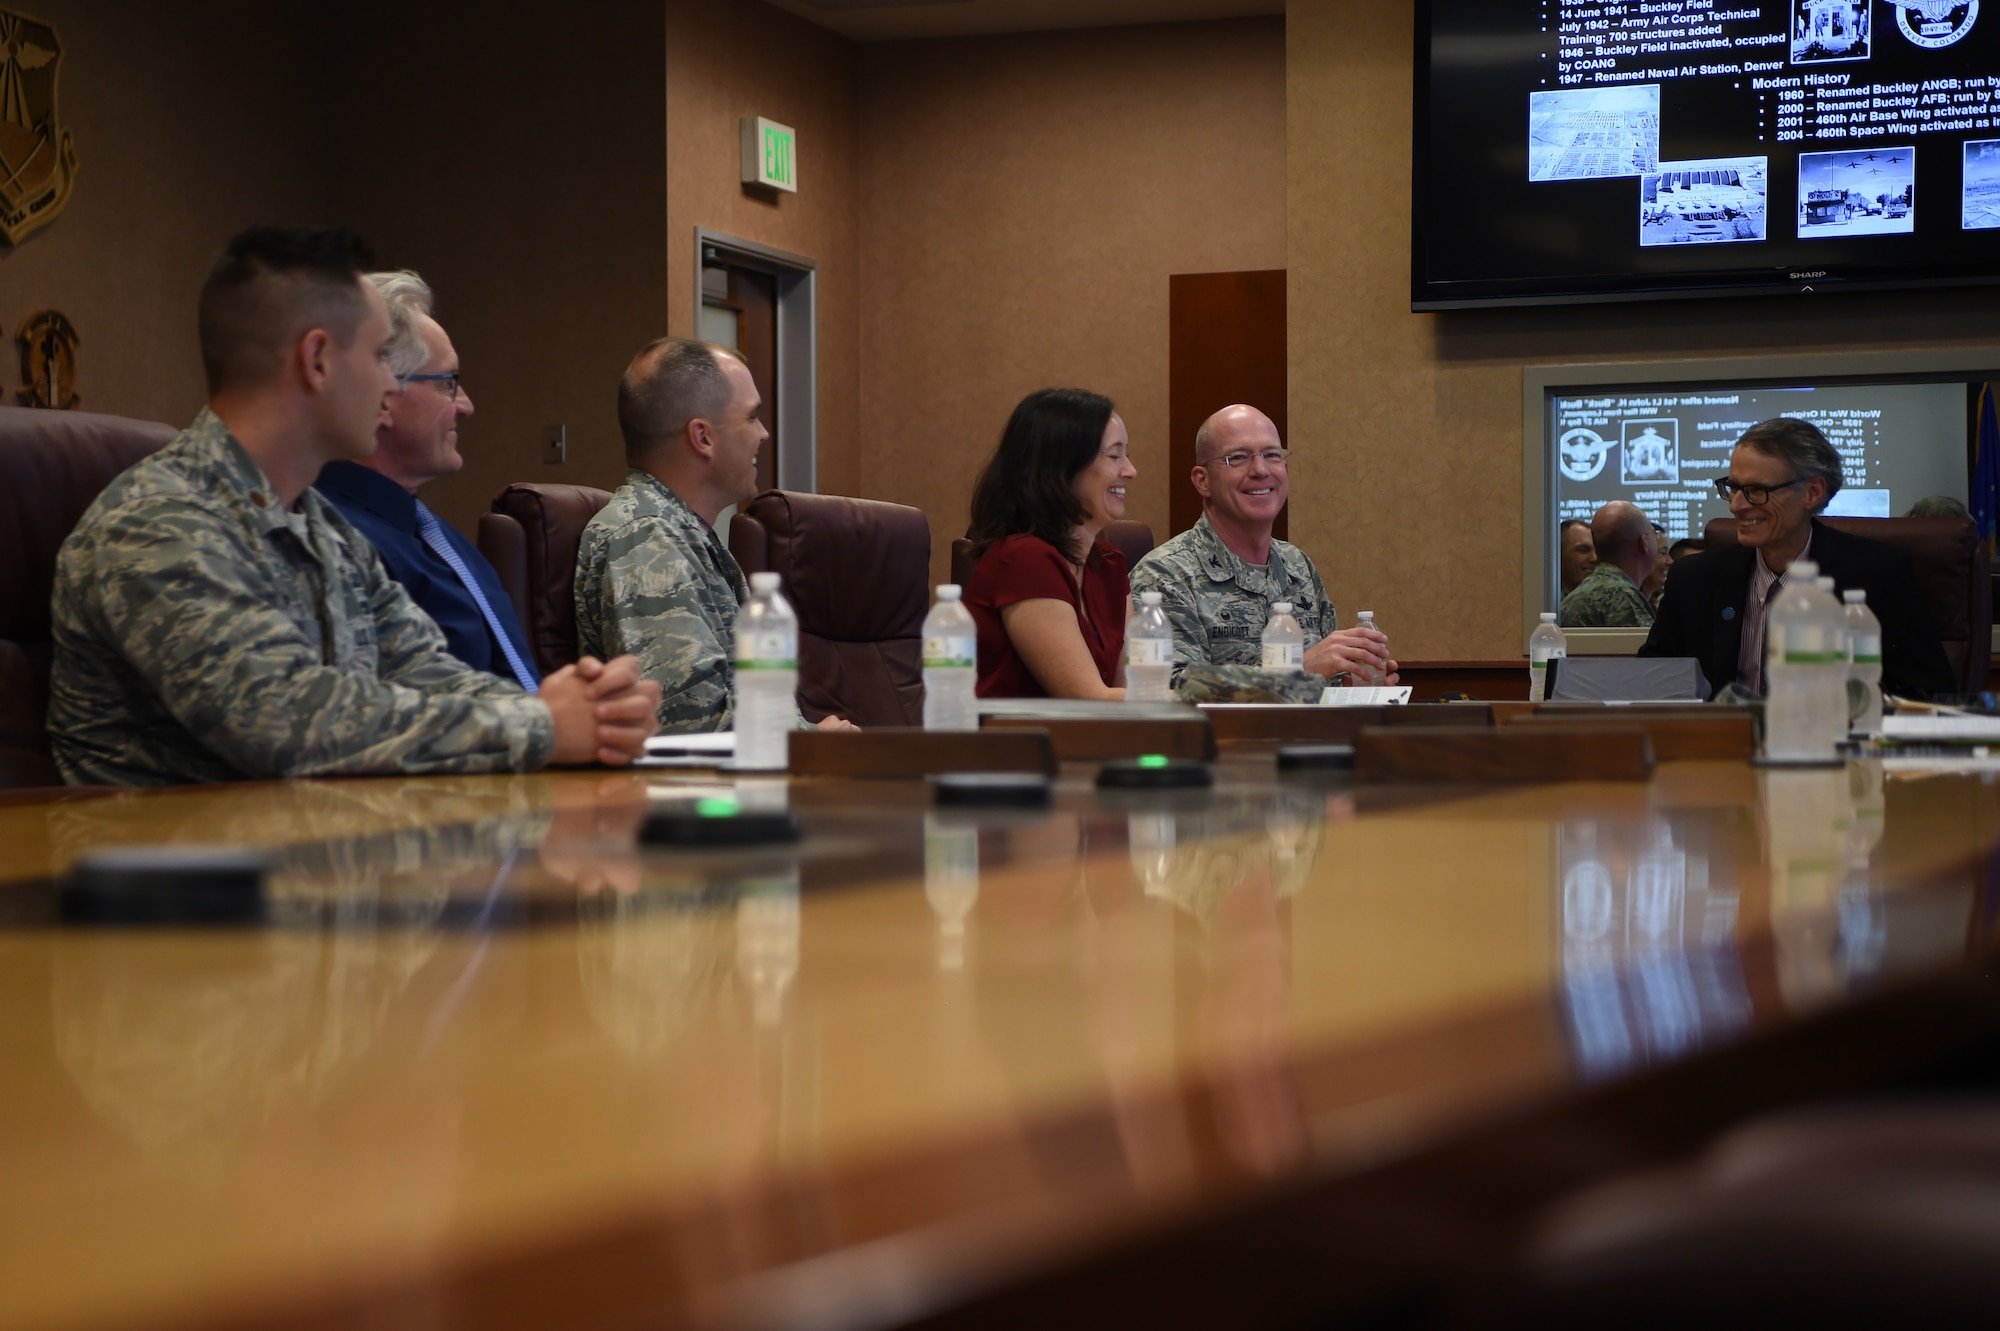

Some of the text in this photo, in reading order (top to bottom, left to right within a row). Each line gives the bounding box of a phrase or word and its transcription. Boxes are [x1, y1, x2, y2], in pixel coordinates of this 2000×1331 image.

[1559, 22, 1581, 33] July
[1584, 20, 1609, 30] 1942
[1620, 18, 1650, 28] Army
[1652, 15, 1669, 25] Air
[1671, 14, 1704, 25] Corps
[1707, 8, 1760, 21] Technical
[1560, 9, 1572, 19] 14
[1574, 8, 1601, 18] June
[1603, 5, 1627, 16] 1941
[1640, 1, 1683, 13] Buckley
[1686, 0, 1713, 9] Field
[1559, 24, 1722, 45] Training; 700 structures added
[1933, 15, 1974, 46] COLORADO
[1559, 48, 1584, 58] 1946
[1595, 45, 1638, 56] Buckley
[1640, 42, 1667, 53] Field
[1670, 37, 1732, 51] inactivated,
[1735, 33, 1786, 46] occupied
[1559, 58, 1616, 73] by COANG
[1559, 73, 1583, 84] 1947
[1595, 70, 1645, 82] Renamed
[1647, 67, 1678, 78] Naval
[1680, 66, 1697, 76] Air
[1699, 64, 1742, 75] Station,
[1744, 61, 1784, 72] Denver
[1752, 74, 1851, 89] Modern History
[1778, 90, 1804, 101] 1960
[1816, 85, 1870, 98] Renamed
[1872, 82, 1919, 94] Buckley
[1921, 79, 1961, 91] ANGB;
[1964, 78, 1985, 88] run
[1987, 76, 2000, 88] by
[1777, 103, 1804, 114] 2000
[1816, 99, 1870, 112] Renamed
[1872, 96, 1918, 108] Buckley
[1921, 93, 1951, 105] AFB;
[1953, 93, 1974, 102] run
[1977, 91, 1991, 102] by
[1777, 117, 1803, 127] 2001
[1815, 114, 1847, 125] 460th
[1849, 112, 1867, 122] Air
[1869, 111, 1899, 121] Base
[1900, 109, 1931, 120] Wing
[1933, 103, 1987, 117] activated
[1777, 130, 1804, 141] 2004
[1815, 127, 1847, 138] 460th
[1849, 126, 1885, 138] Space
[1887, 123, 1918, 134] Wing
[1920, 119, 1973, 132] activated
[1975, 119, 1989, 128] as
[765, 127, 791, 185] EXIT
[1790, 271, 1826, 279] SHARP
[1212, 626, 1250, 638] ENDICOTT
